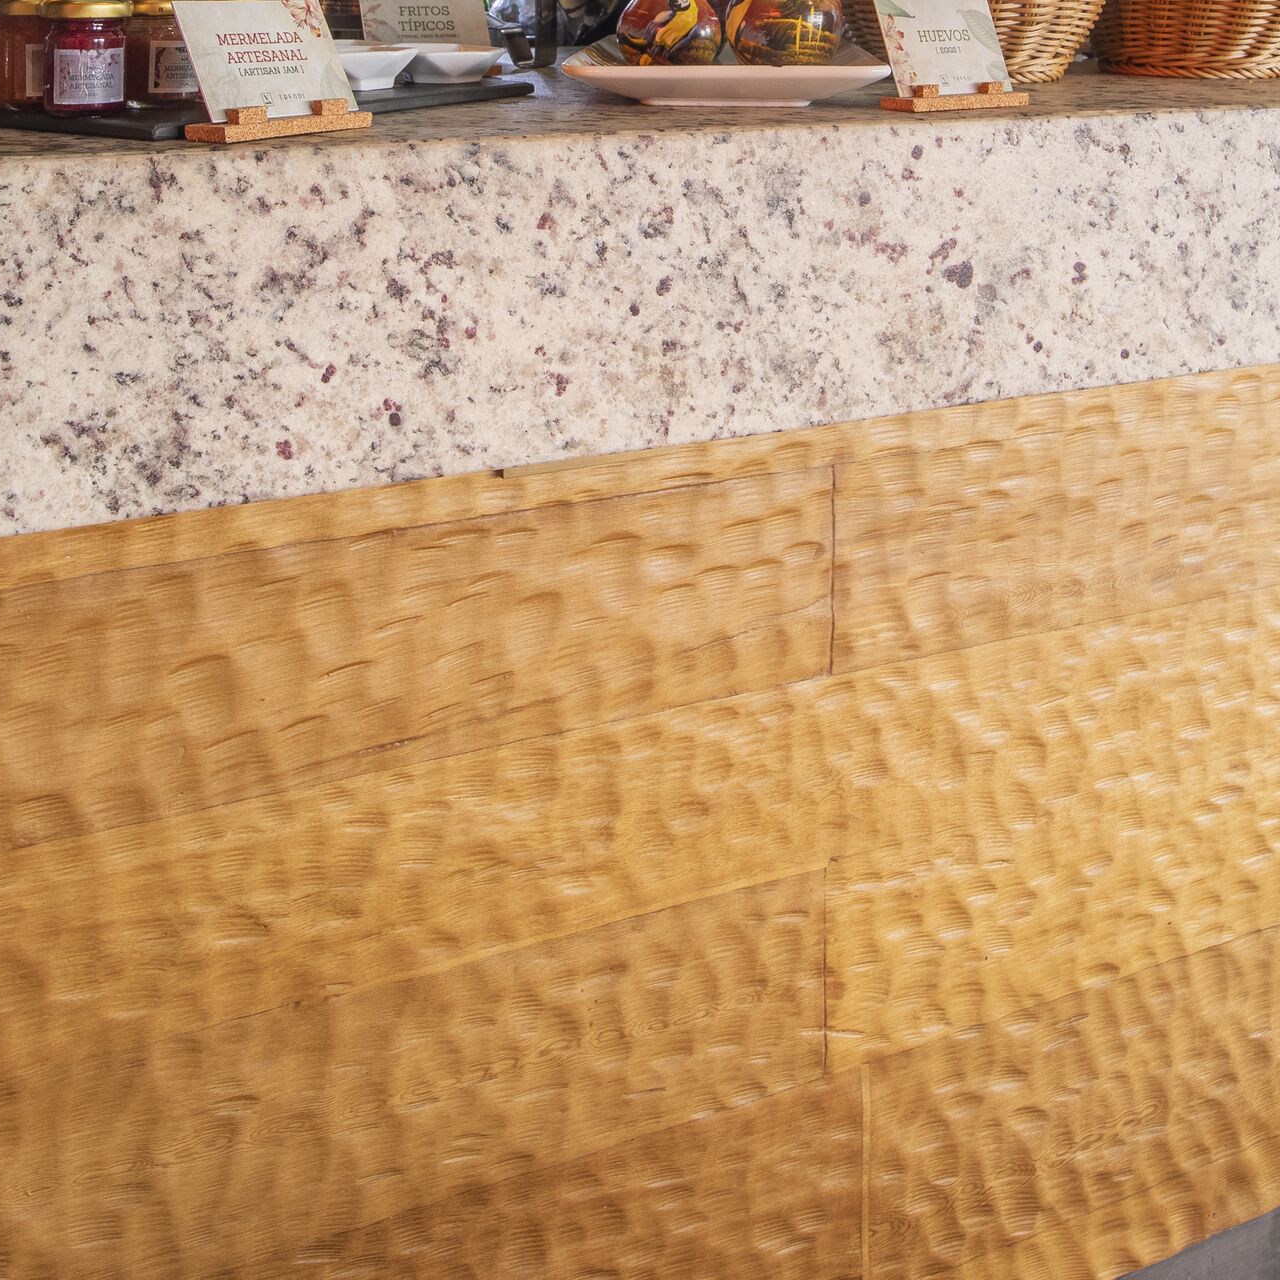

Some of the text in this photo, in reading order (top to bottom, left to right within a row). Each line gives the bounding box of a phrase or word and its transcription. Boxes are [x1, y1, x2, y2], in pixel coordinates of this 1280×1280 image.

[399, 5, 450, 17] FRITOS
[398, 17, 455, 31] TÍPICOS
[216, 31, 303, 46] MERMELADA
[917, 29, 971, 42] HUEVOS
[227, 49, 308, 64] ARTESANAL
